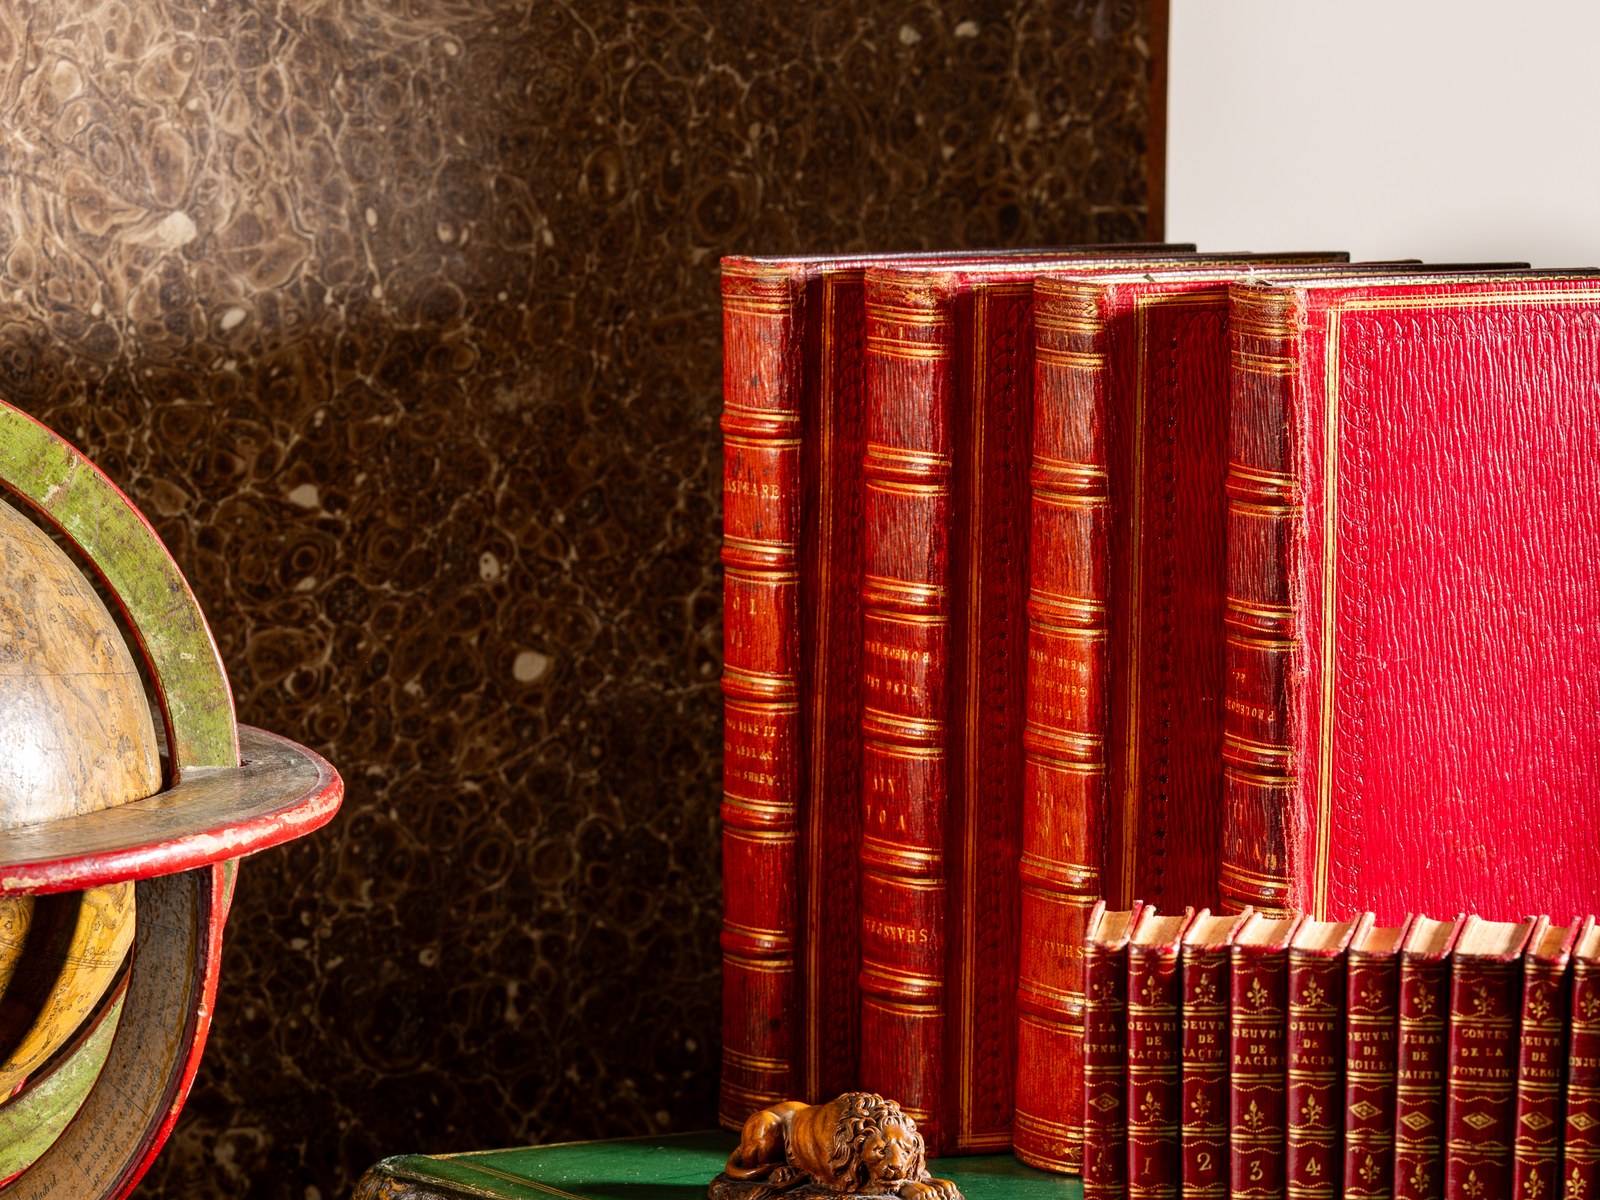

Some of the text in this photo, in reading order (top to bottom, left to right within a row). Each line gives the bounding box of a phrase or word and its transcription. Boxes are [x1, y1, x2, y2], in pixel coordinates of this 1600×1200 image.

[1098, 1023, 1117, 1032] LA
[1197, 1034, 1215, 1044] DE
[1461, 1028, 1509, 1040] CONTES
[1146, 1036, 1162, 1046] DE
[1303, 1038, 1319, 1049] DE
[1250, 1044, 1266, 1054] DE
[1363, 1046, 1379, 1056] DE
[1461, 1047, 1503, 1057] DE LA
[1412, 1051, 1428, 1061] DE
[1531, 1051, 1547, 1062] DE
[1197, 1152, 1212, 1171] 2
[1304, 1157, 1321, 1176] 4
[1249, 1160, 1263, 1181] 3
